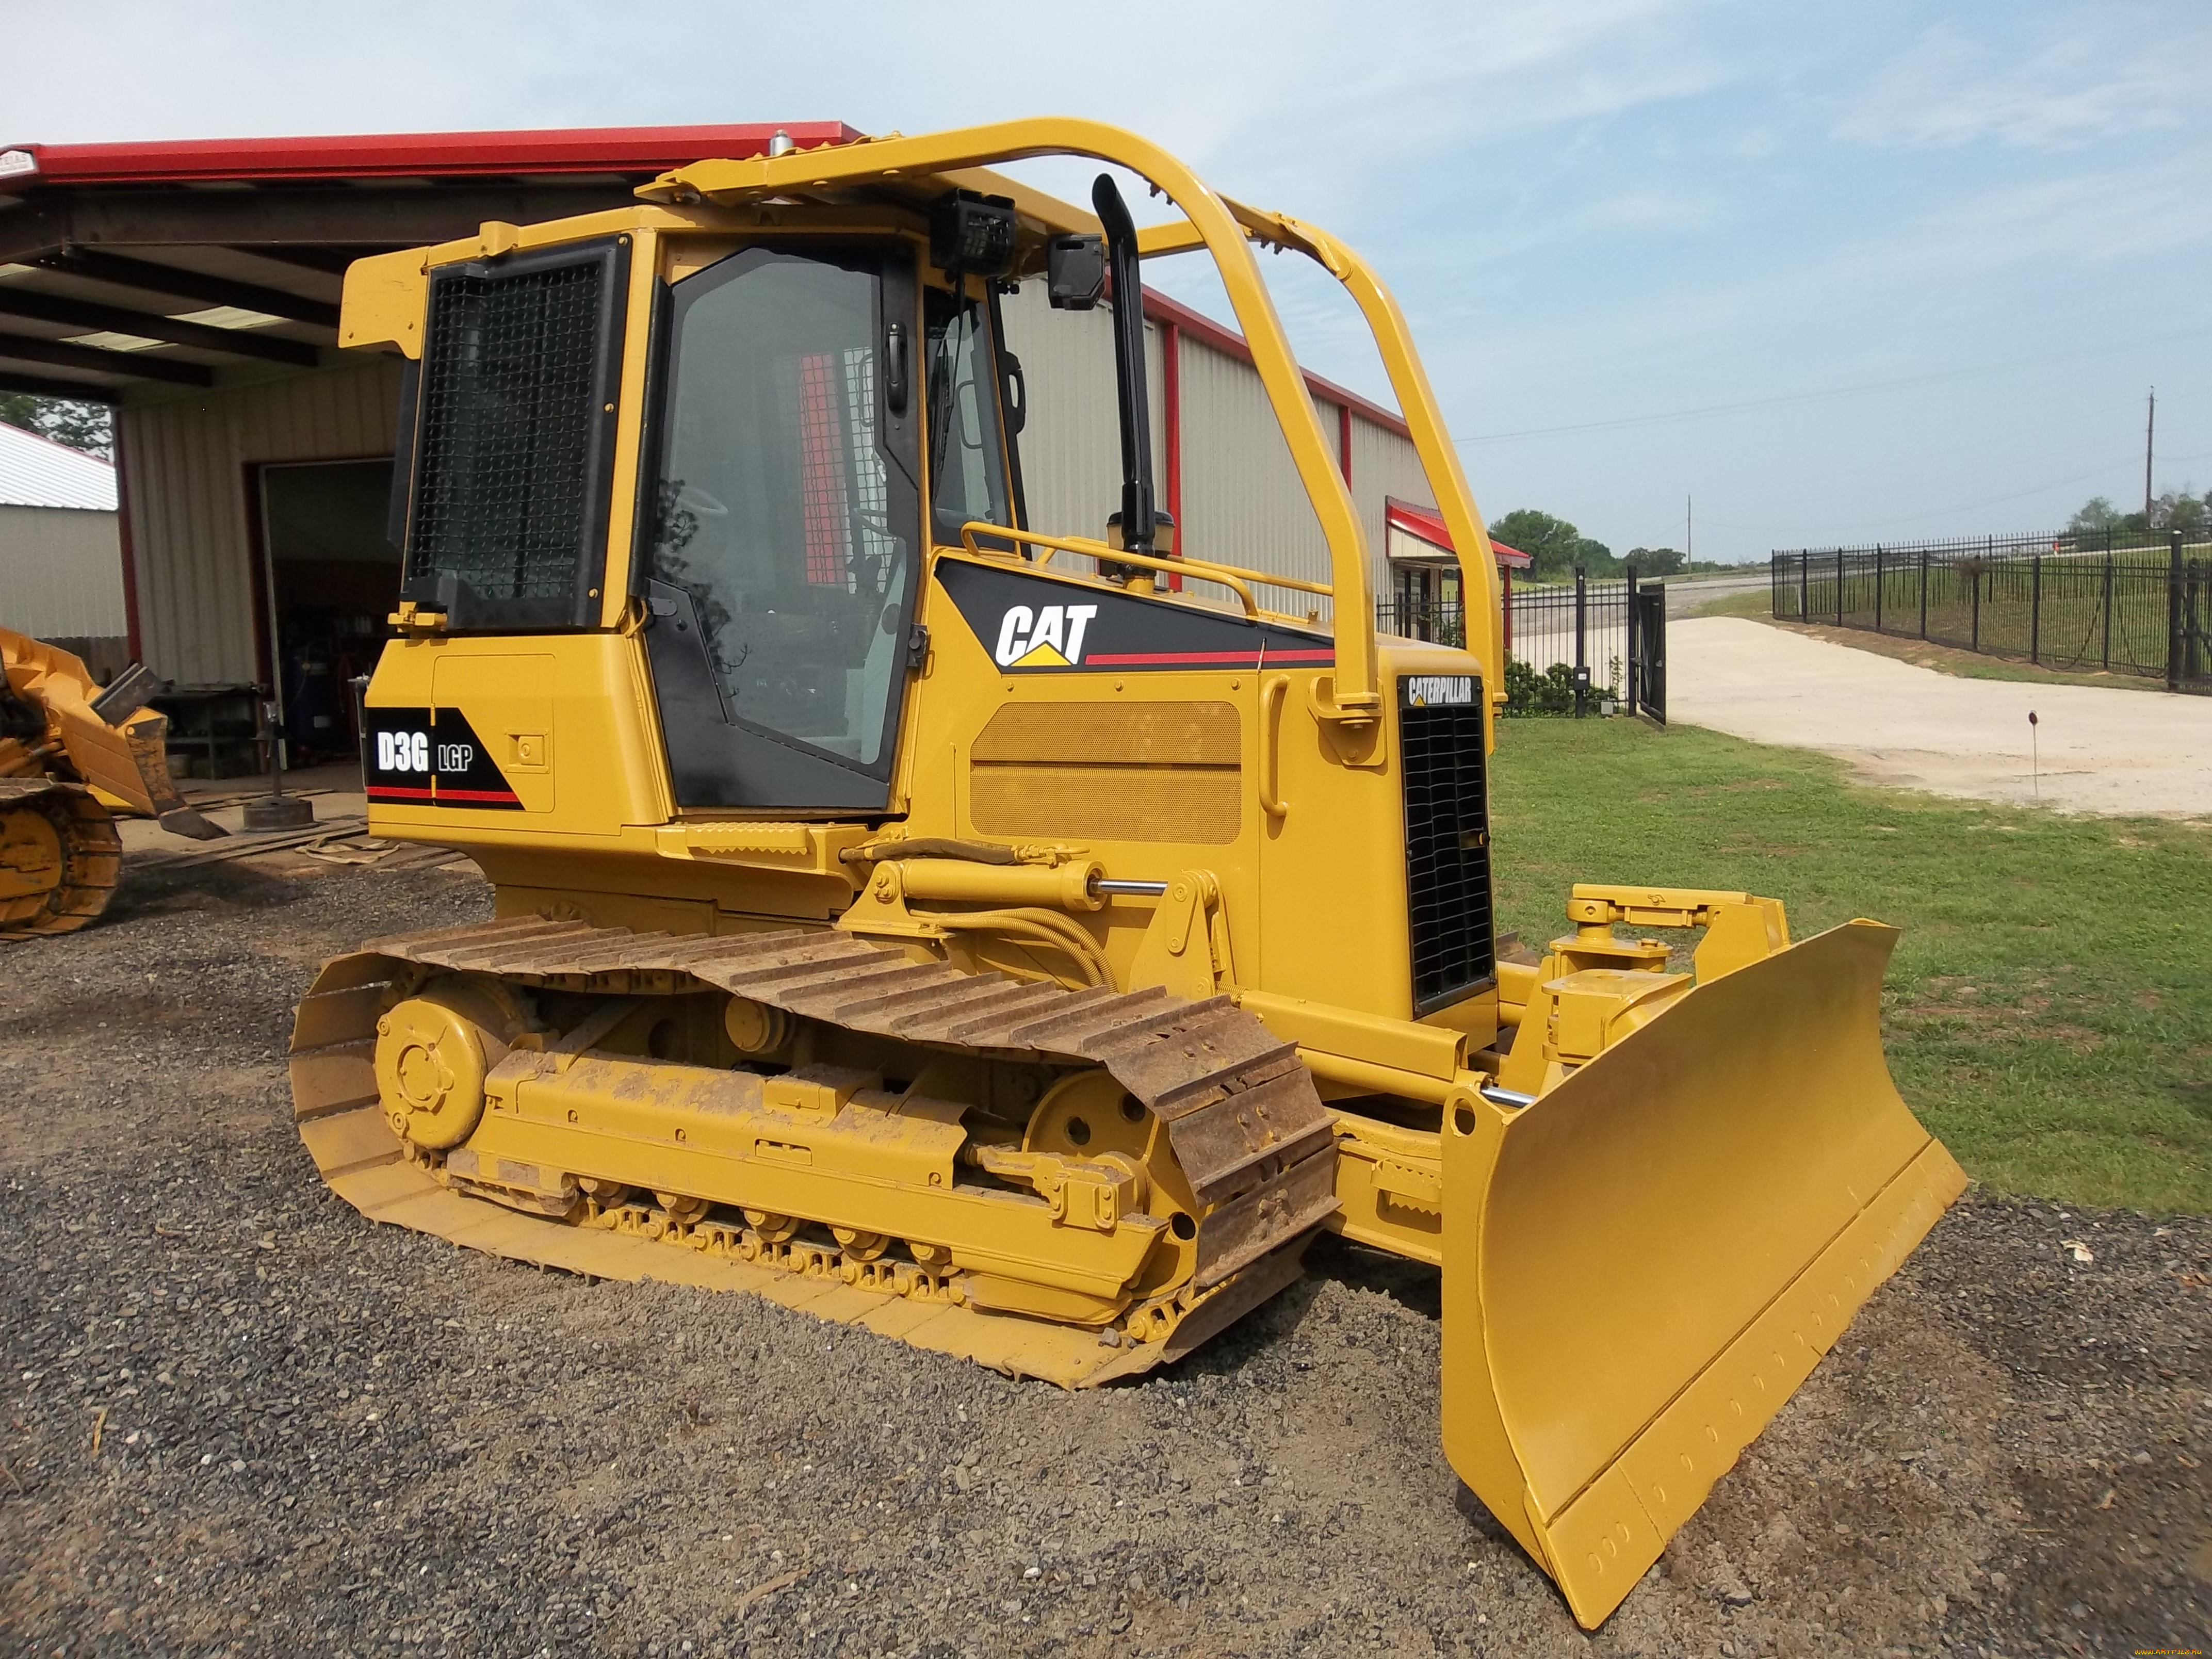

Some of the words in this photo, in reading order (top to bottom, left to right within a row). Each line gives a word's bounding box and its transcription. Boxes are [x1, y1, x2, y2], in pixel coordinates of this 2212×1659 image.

[995, 605, 1098, 666] CAT
[1409, 677, 1471, 706] CATERPILLAR
[377, 731, 429, 772] D3G
[438, 744, 473, 772] LGP
